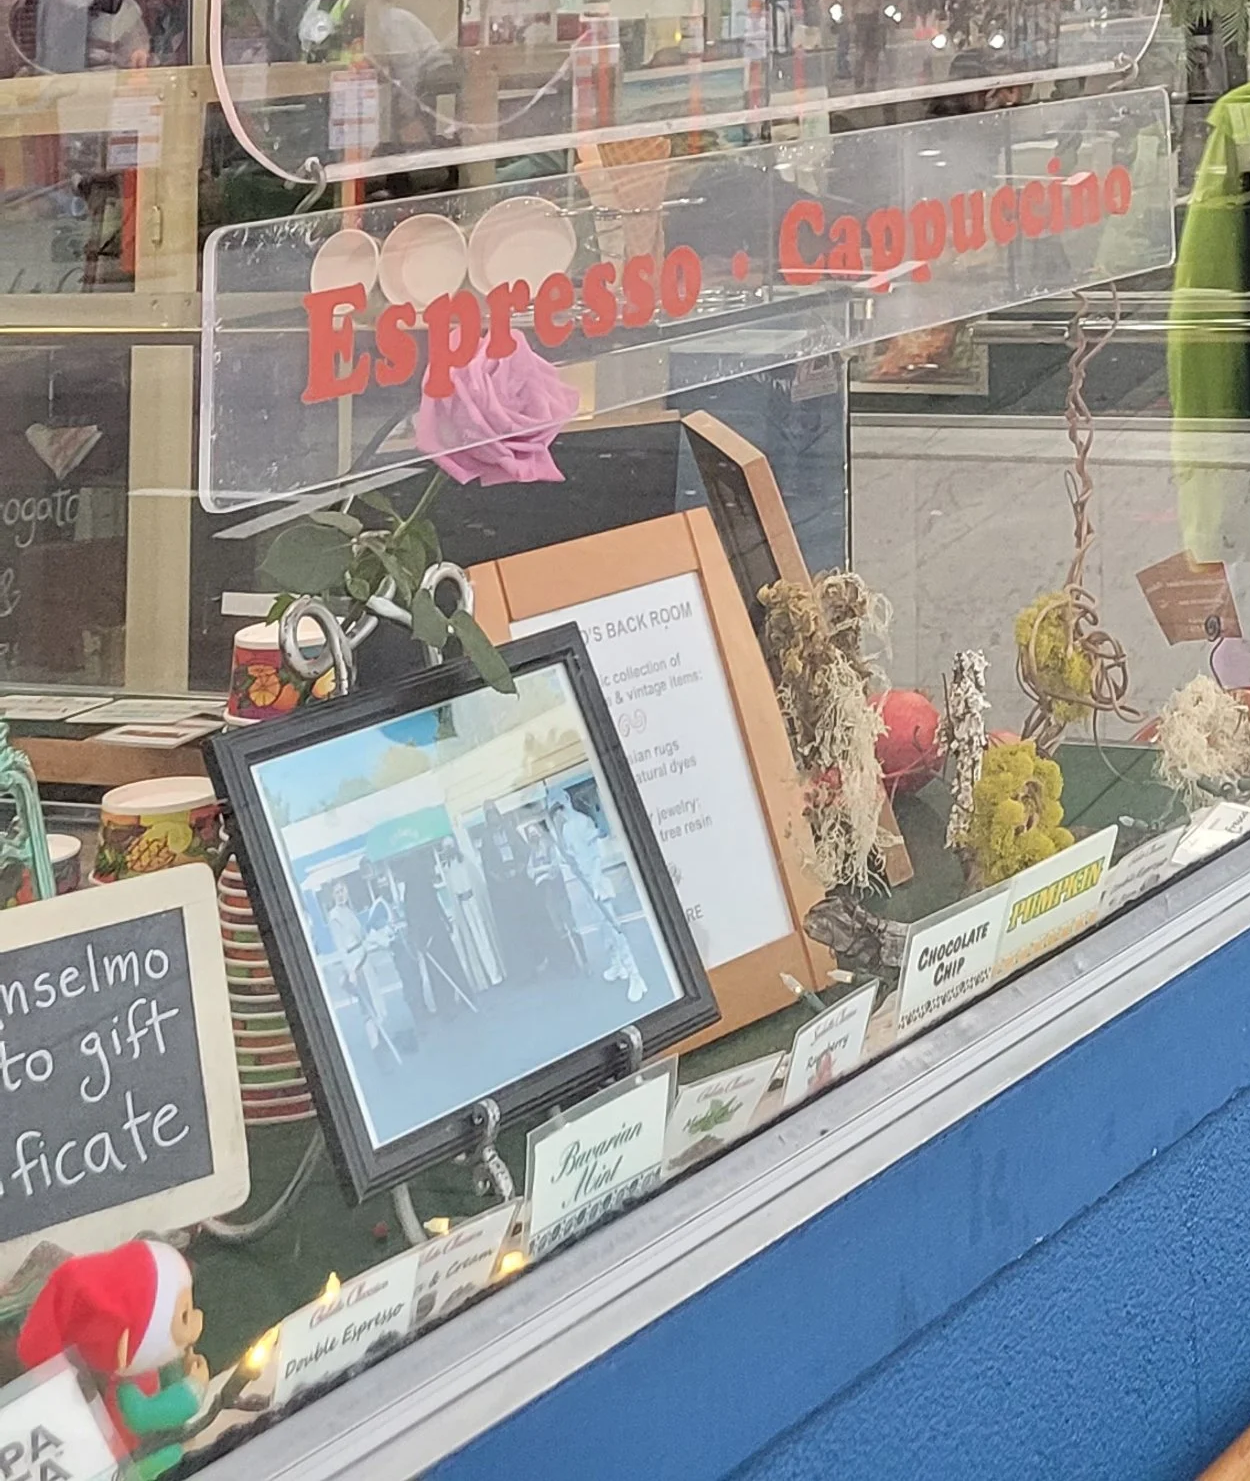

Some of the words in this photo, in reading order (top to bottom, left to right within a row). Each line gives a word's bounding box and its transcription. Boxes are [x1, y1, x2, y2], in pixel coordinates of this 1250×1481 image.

[301, 245, 702, 404] Espresso
[778, 158, 1132, 293] Cappuccino
[605, 613, 648, 639] BACK
[649, 601, 693, 627] ROOM
[612, 659, 667, 685] collection
[670, 652, 682, 668] of
[626, 681, 667, 701] vintage
[654, 739, 680, 758] rugs
[670, 755, 697, 776] dyes
[659, 824, 683, 843] tree
[684, 814, 713, 834] resin
[1006, 857, 1105, 933] PUMPKIN
[917, 922, 990, 971] CHOCOLATE
[933, 956, 965, 987] CHIP
[1, 1041, 53, 1092] to
[80, 998, 180, 1102] gift
[551, 1120, 643, 1184] Bavarian
[562, 1157, 623, 1210] Mint
[284, 1335, 339, 1380] Double
[342, 1302, 405, 1348] Espresso
